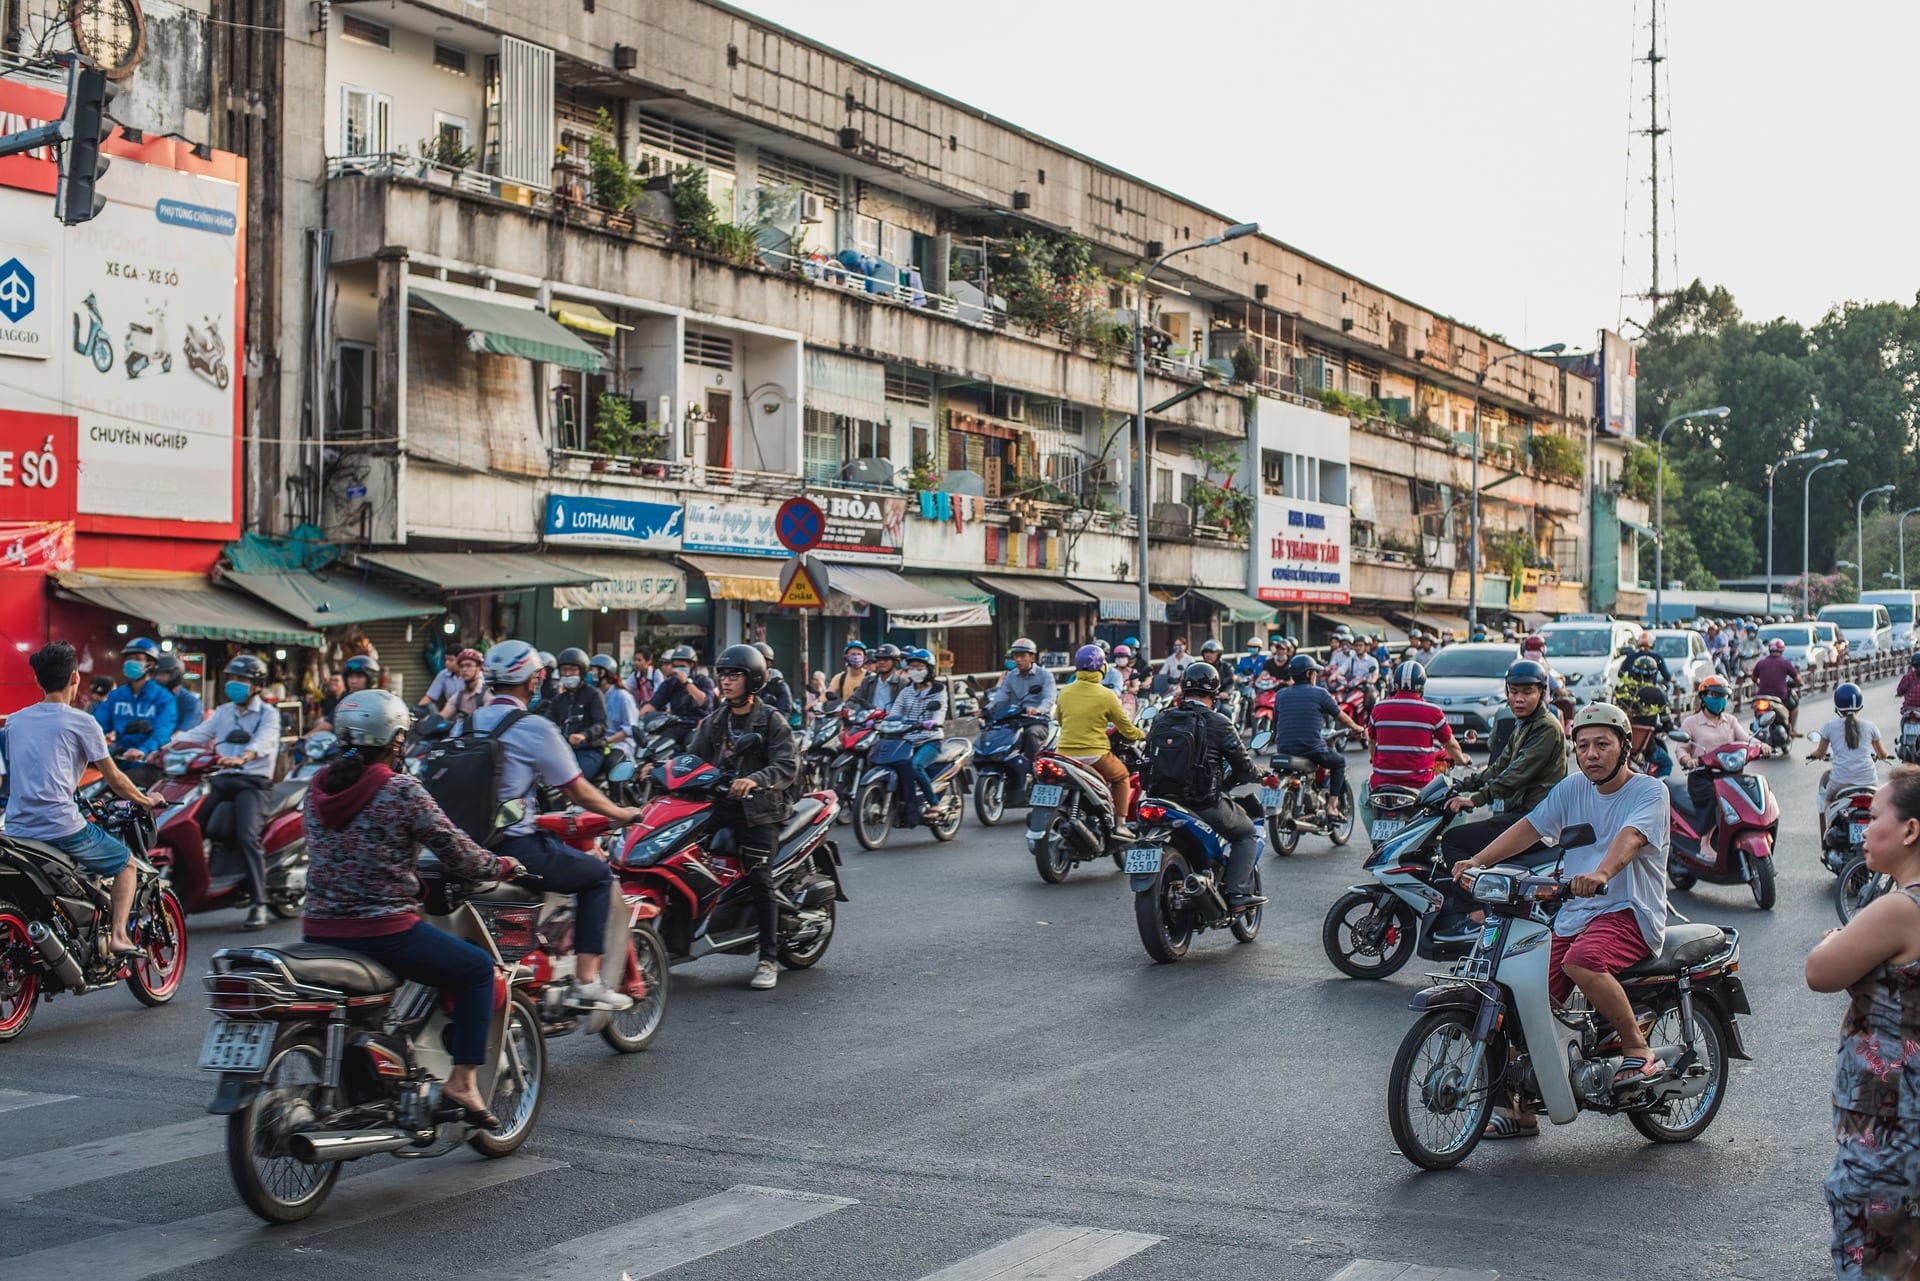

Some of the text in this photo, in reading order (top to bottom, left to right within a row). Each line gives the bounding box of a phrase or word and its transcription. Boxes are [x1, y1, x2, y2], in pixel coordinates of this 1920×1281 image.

[106, 261, 119, 277] XE
[123, 265, 138, 280] GA
[148, 269, 161, 284] XE
[90, 426, 188, 450] CHUYÊN NGHIỆP
[22, 434, 58, 488] SỐ
[829, 494, 883, 521] HÒA
[572, 511, 635, 532] LOTHAMILK
[1126, 861, 1159, 873] 255.07
[1130, 850, 1156, 861] 49-H1
